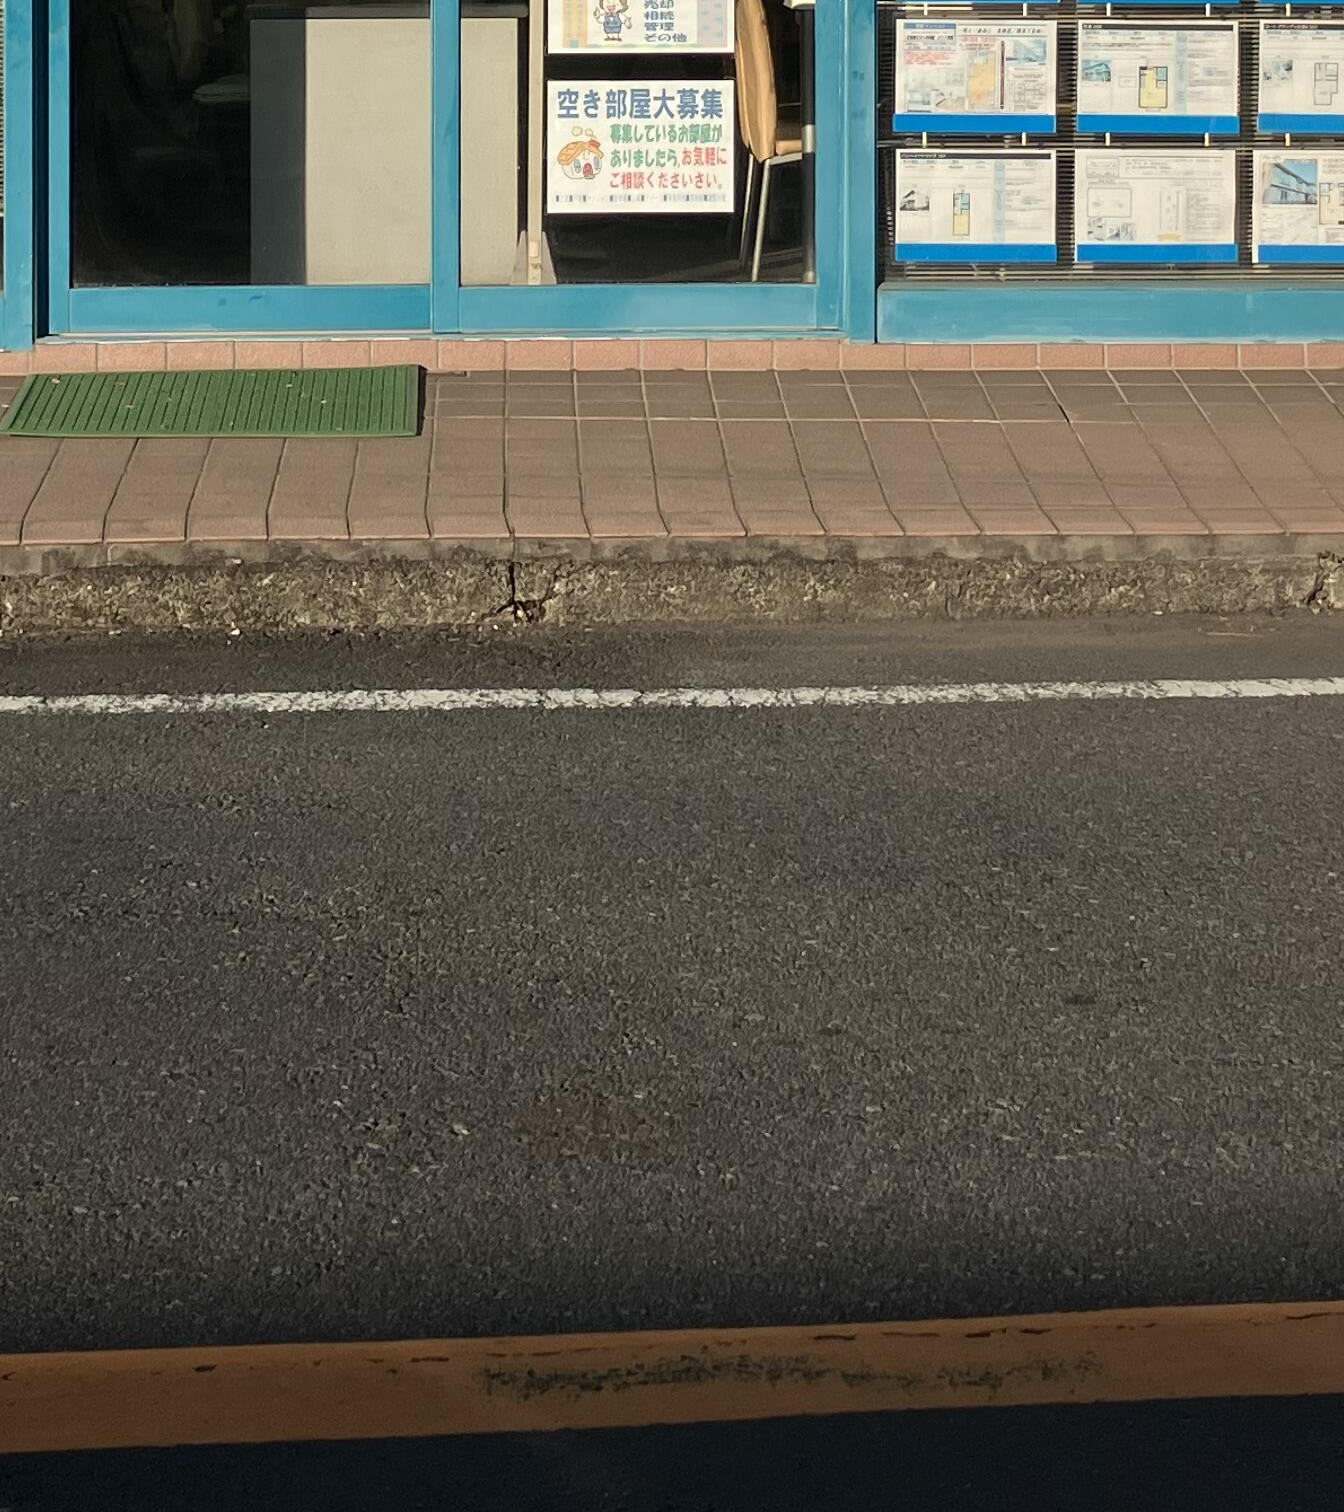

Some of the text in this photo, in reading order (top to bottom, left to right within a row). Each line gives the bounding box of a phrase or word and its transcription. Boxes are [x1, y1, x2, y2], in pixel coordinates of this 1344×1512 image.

[557, 88, 724, 120] 空き部屋大募集
[610, 124, 723, 144] 募集しているお部屋が
